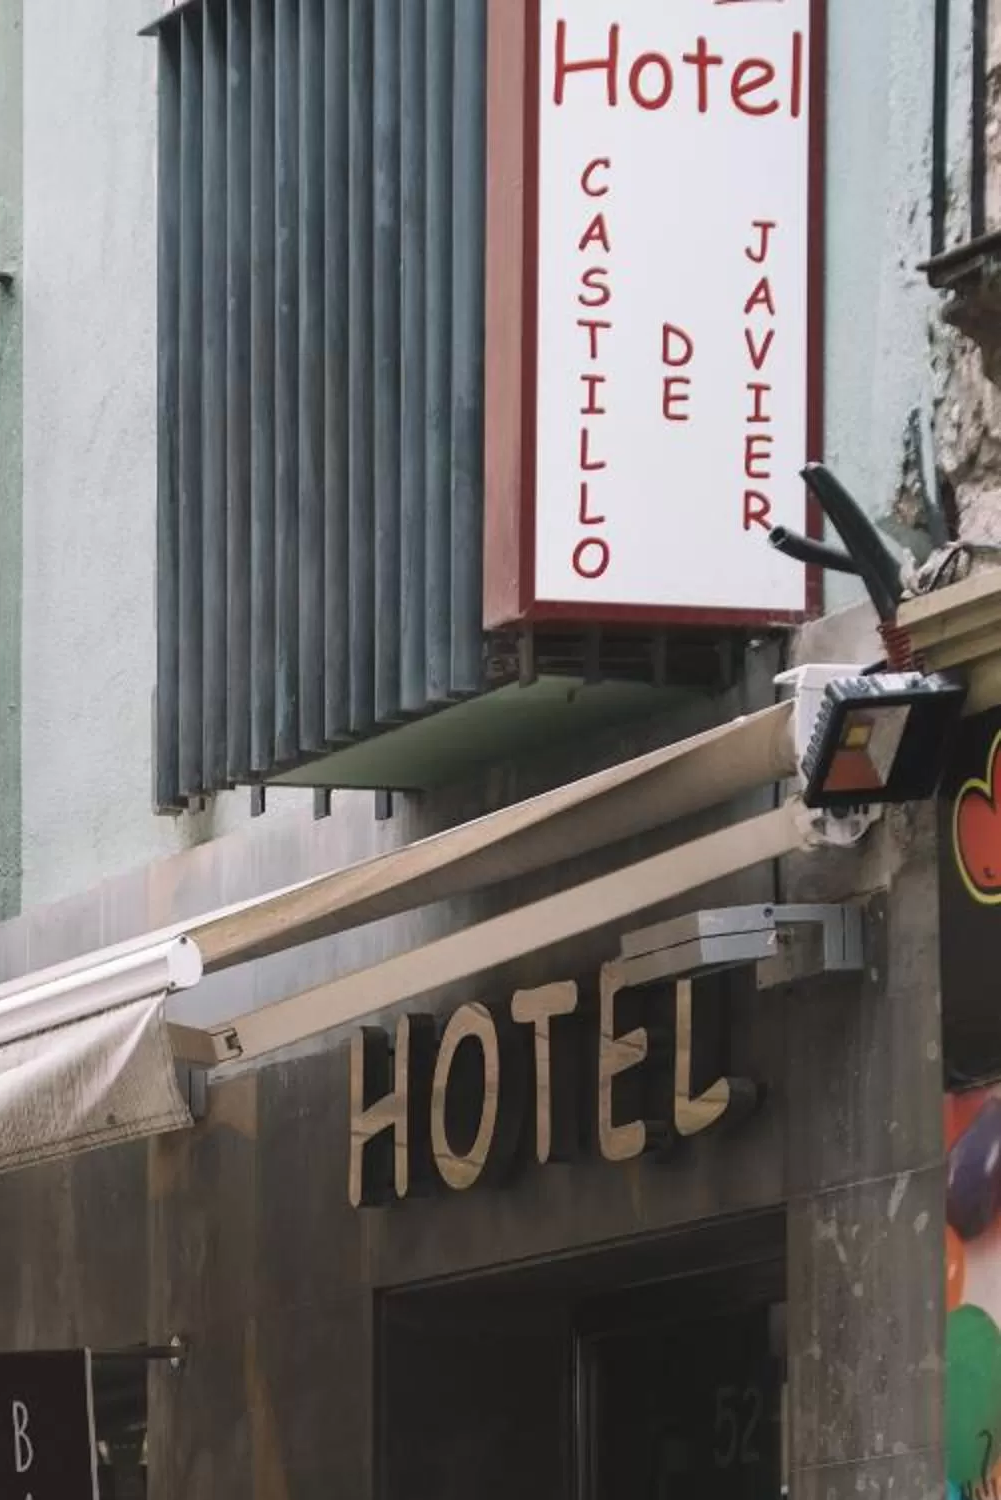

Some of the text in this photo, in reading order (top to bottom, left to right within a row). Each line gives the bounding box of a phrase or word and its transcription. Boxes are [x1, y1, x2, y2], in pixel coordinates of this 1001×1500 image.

[553, 19, 803, 118] Hotel
[572, 157, 612, 579] CASTILLO
[662, 322, 694, 421] DE
[743, 220, 777, 532] JAVIER
[348, 961, 731, 1208] HOTEL
[712, 1384, 764, 1469] 52
